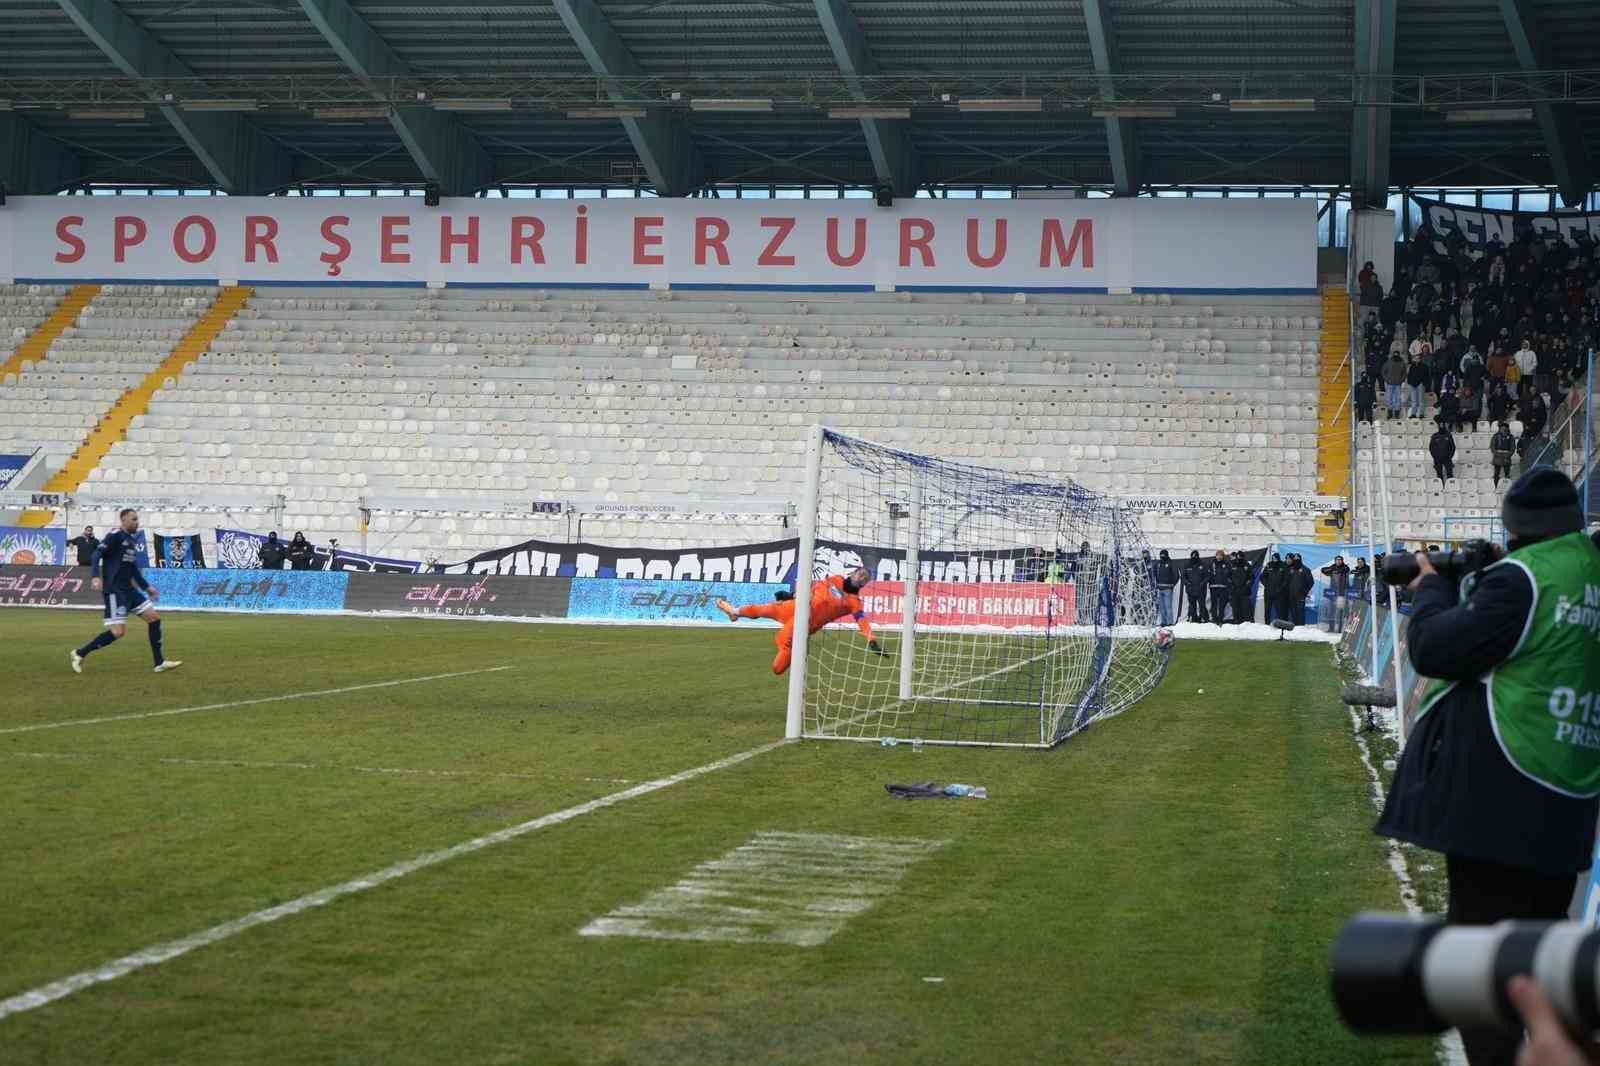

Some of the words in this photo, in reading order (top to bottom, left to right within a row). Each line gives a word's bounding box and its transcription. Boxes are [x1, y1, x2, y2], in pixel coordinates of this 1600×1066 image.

[59, 216, 277, 261] SPOR
[319, 204, 586, 276] ŞEHRİ
[632, 219, 1092, 267] ERZURUM
[938, 597, 977, 616] SPOR
